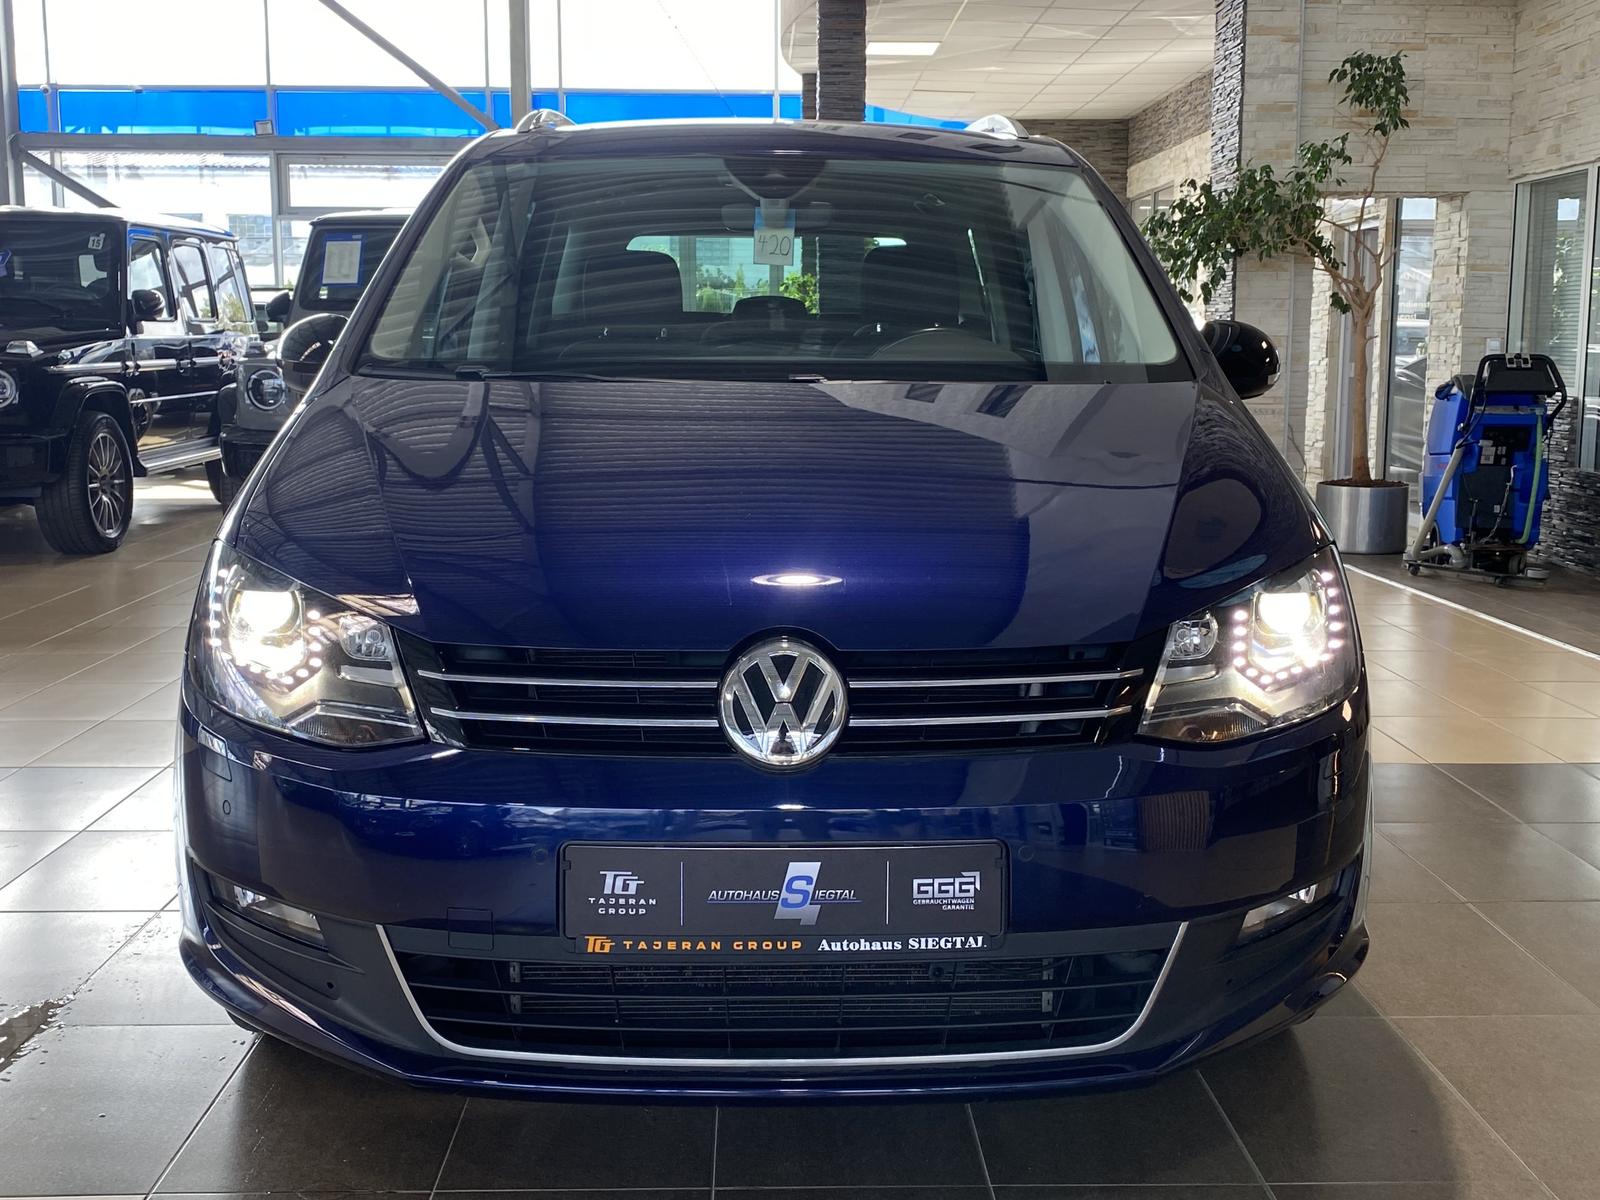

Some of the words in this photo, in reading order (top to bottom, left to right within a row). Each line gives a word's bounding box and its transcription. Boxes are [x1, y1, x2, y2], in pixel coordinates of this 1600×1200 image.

[757, 234, 791, 256] 420
[912, 877, 975, 898] GGG
[588, 897, 657, 905] TAJERAN
[707, 889, 780, 901] AUTOHAUS
[598, 907, 646, 915] GROUP
[623, 940, 721, 950] TAJERAN
[733, 941, 802, 950] GROUP
[817, 938, 902, 951] Autohaus
